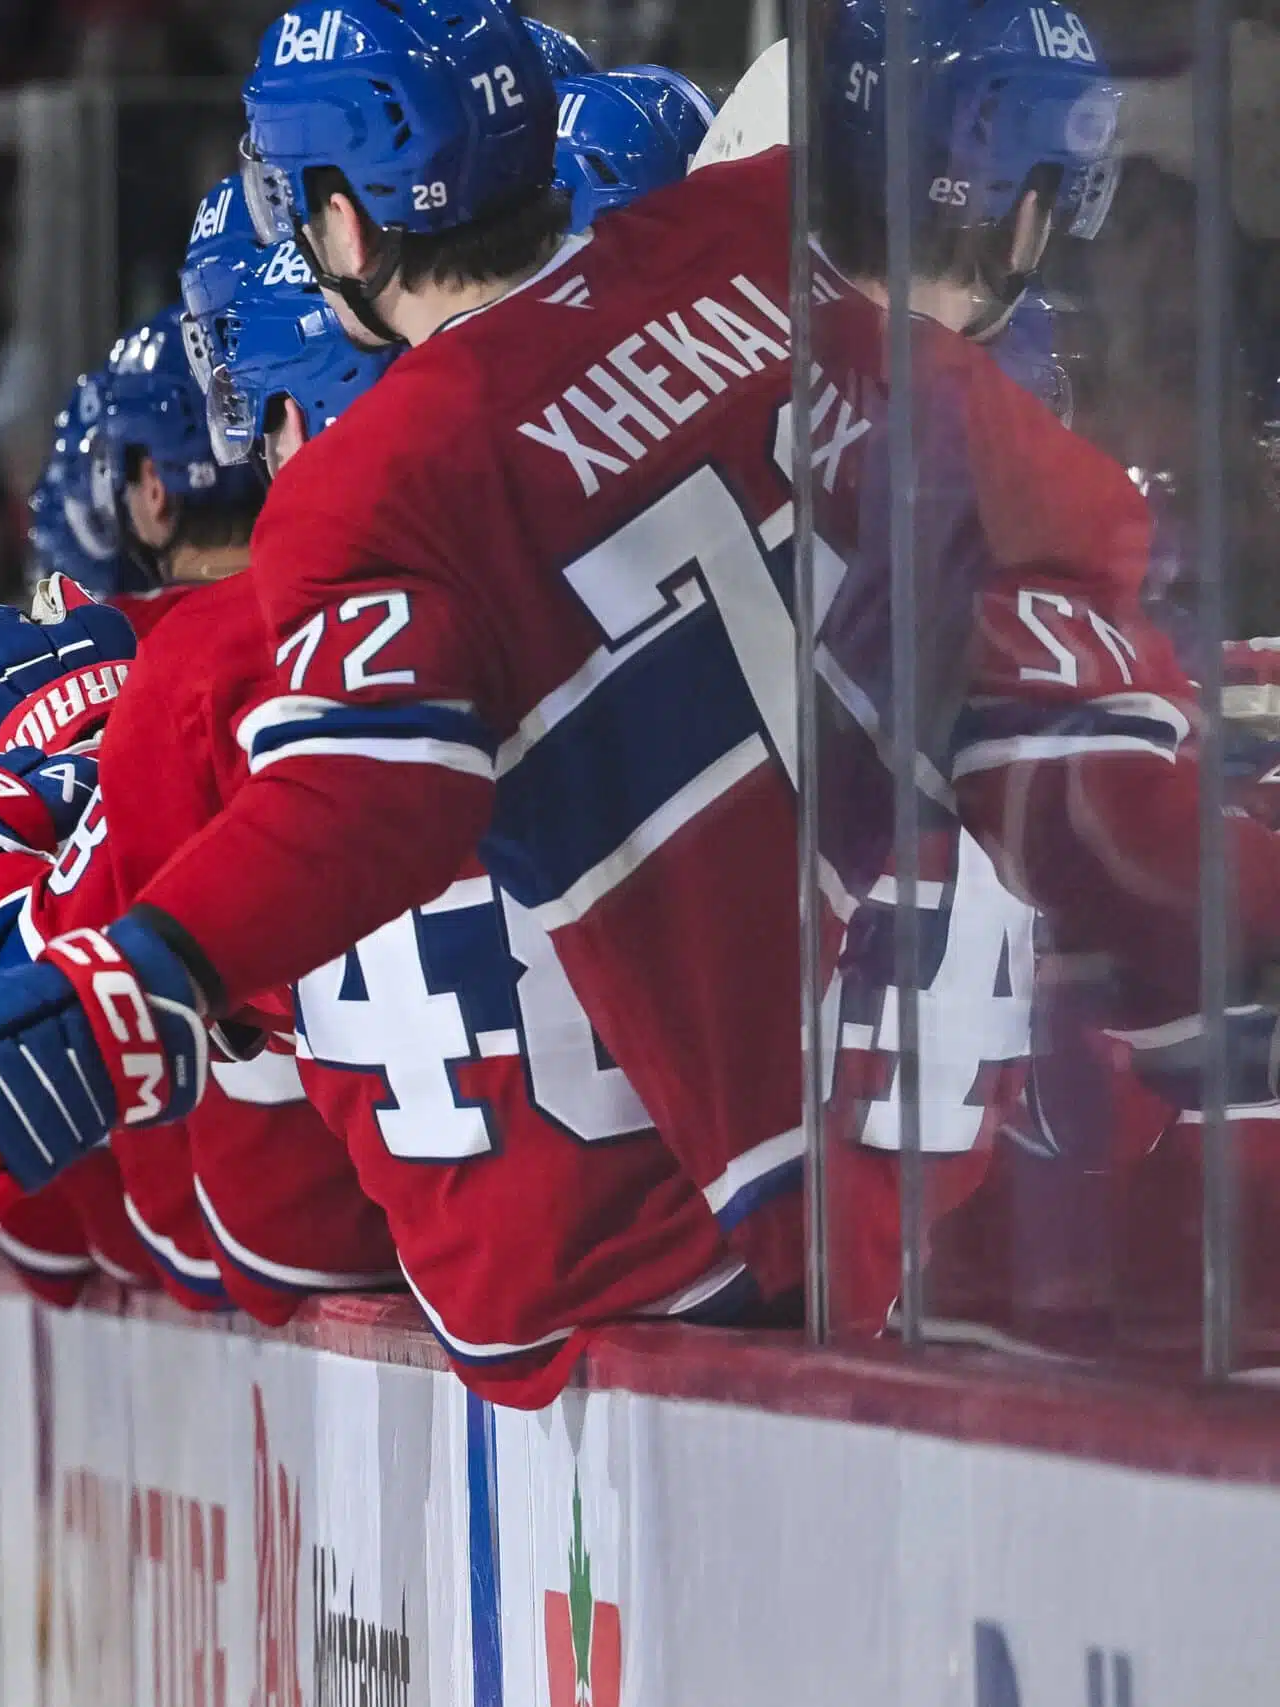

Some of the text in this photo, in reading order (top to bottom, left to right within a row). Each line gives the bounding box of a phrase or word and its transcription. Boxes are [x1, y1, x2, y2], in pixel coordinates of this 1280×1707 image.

[274, 10, 343, 66] Bell
[471, 64, 524, 116] 72
[557, 93, 586, 138] ll
[190, 188, 233, 245] Bell
[412, 181, 448, 211] 29
[263, 240, 318, 286] Be
[563, 400, 800, 794] 7
[276, 589, 416, 692] 72
[47, 927, 164, 1126] CCM
